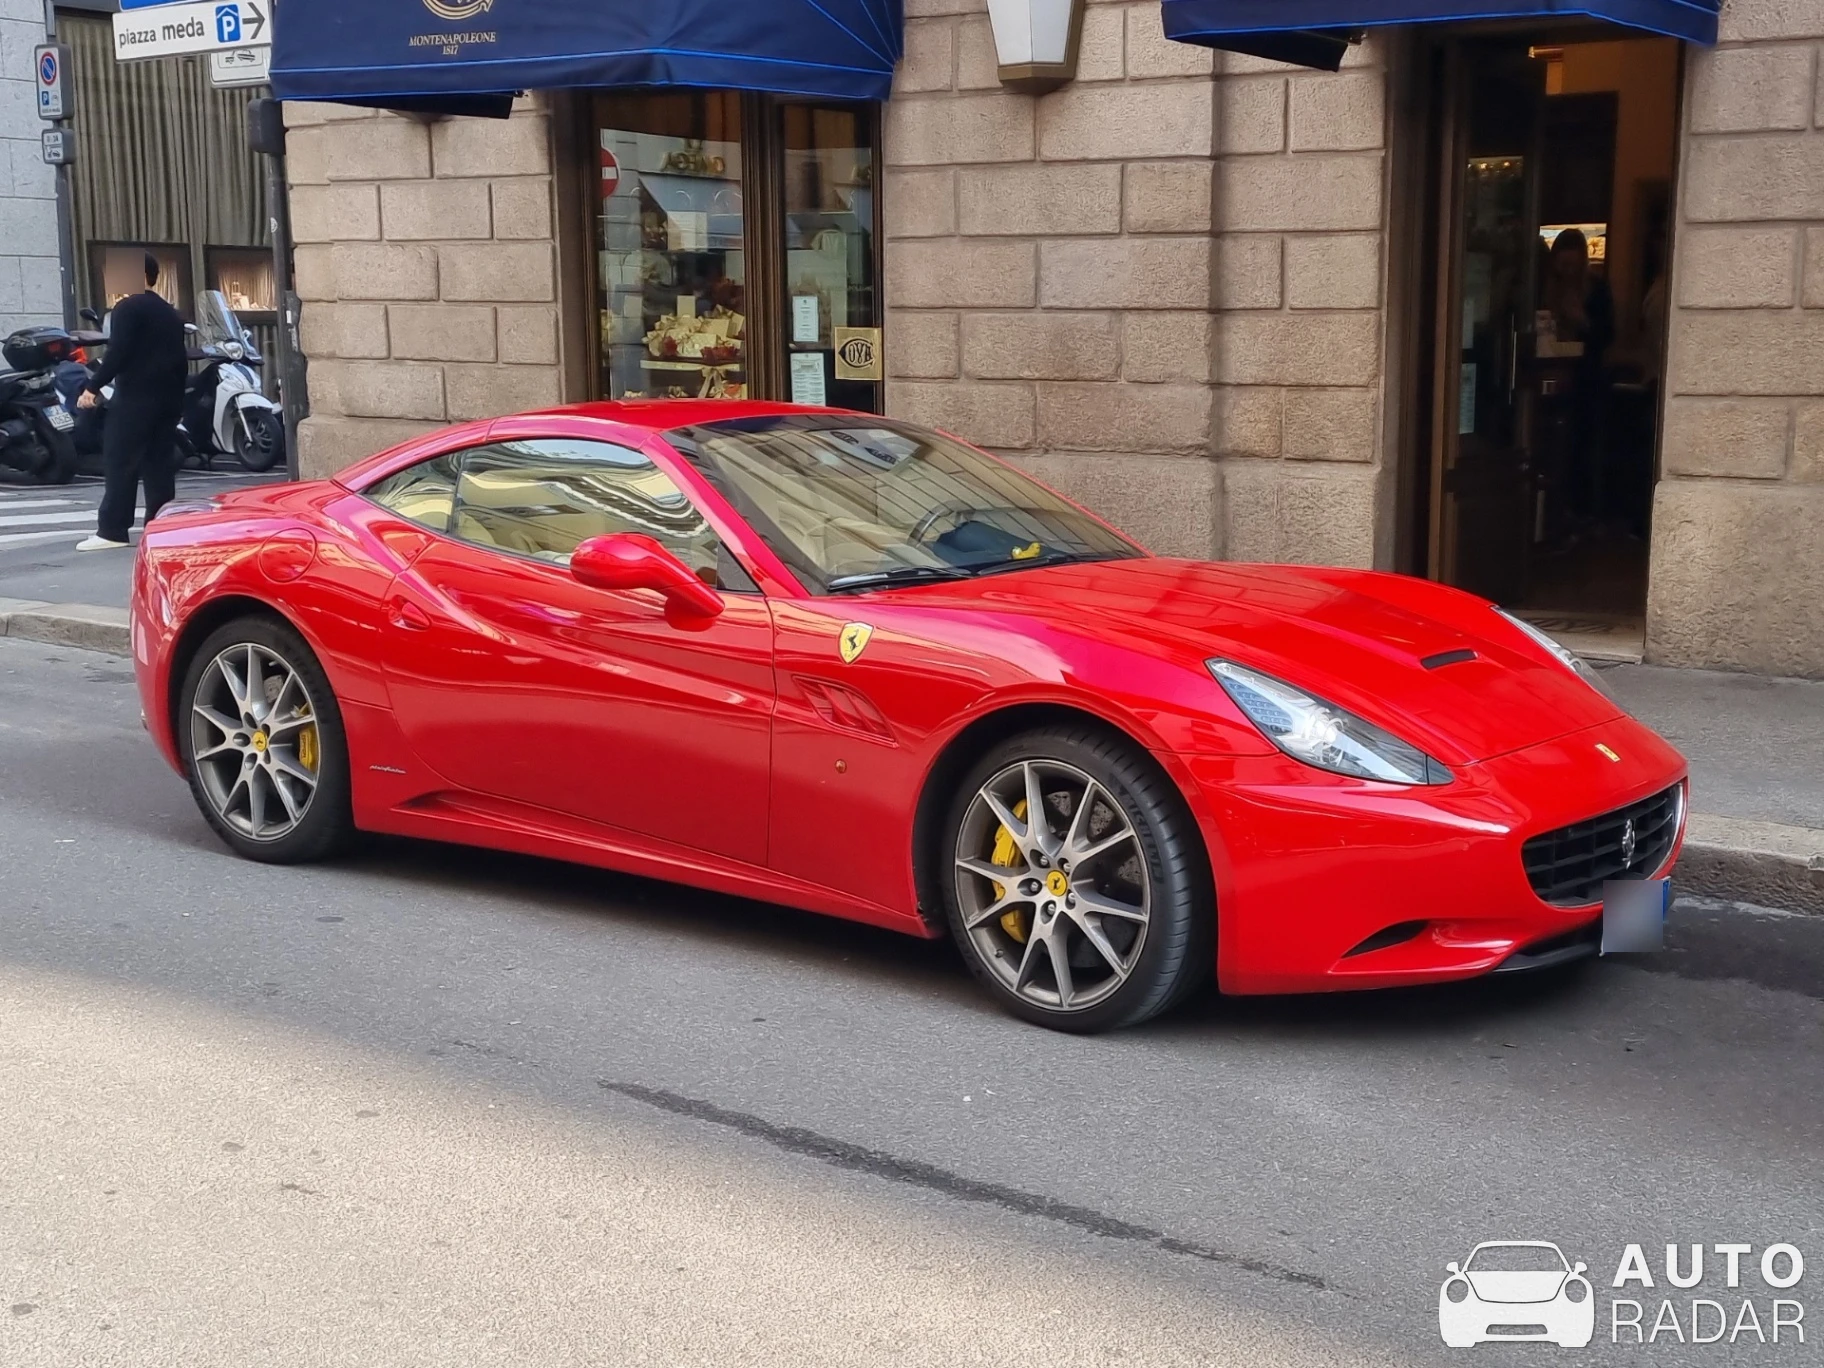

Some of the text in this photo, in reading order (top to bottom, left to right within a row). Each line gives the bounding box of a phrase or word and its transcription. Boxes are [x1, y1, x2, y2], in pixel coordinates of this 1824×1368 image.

[119, 28, 157, 48] piazza
[162, 16, 205, 41] meda
[408, 31, 496, 47] MONTENAPOLEONE
[442, 45, 459, 55] 1817
